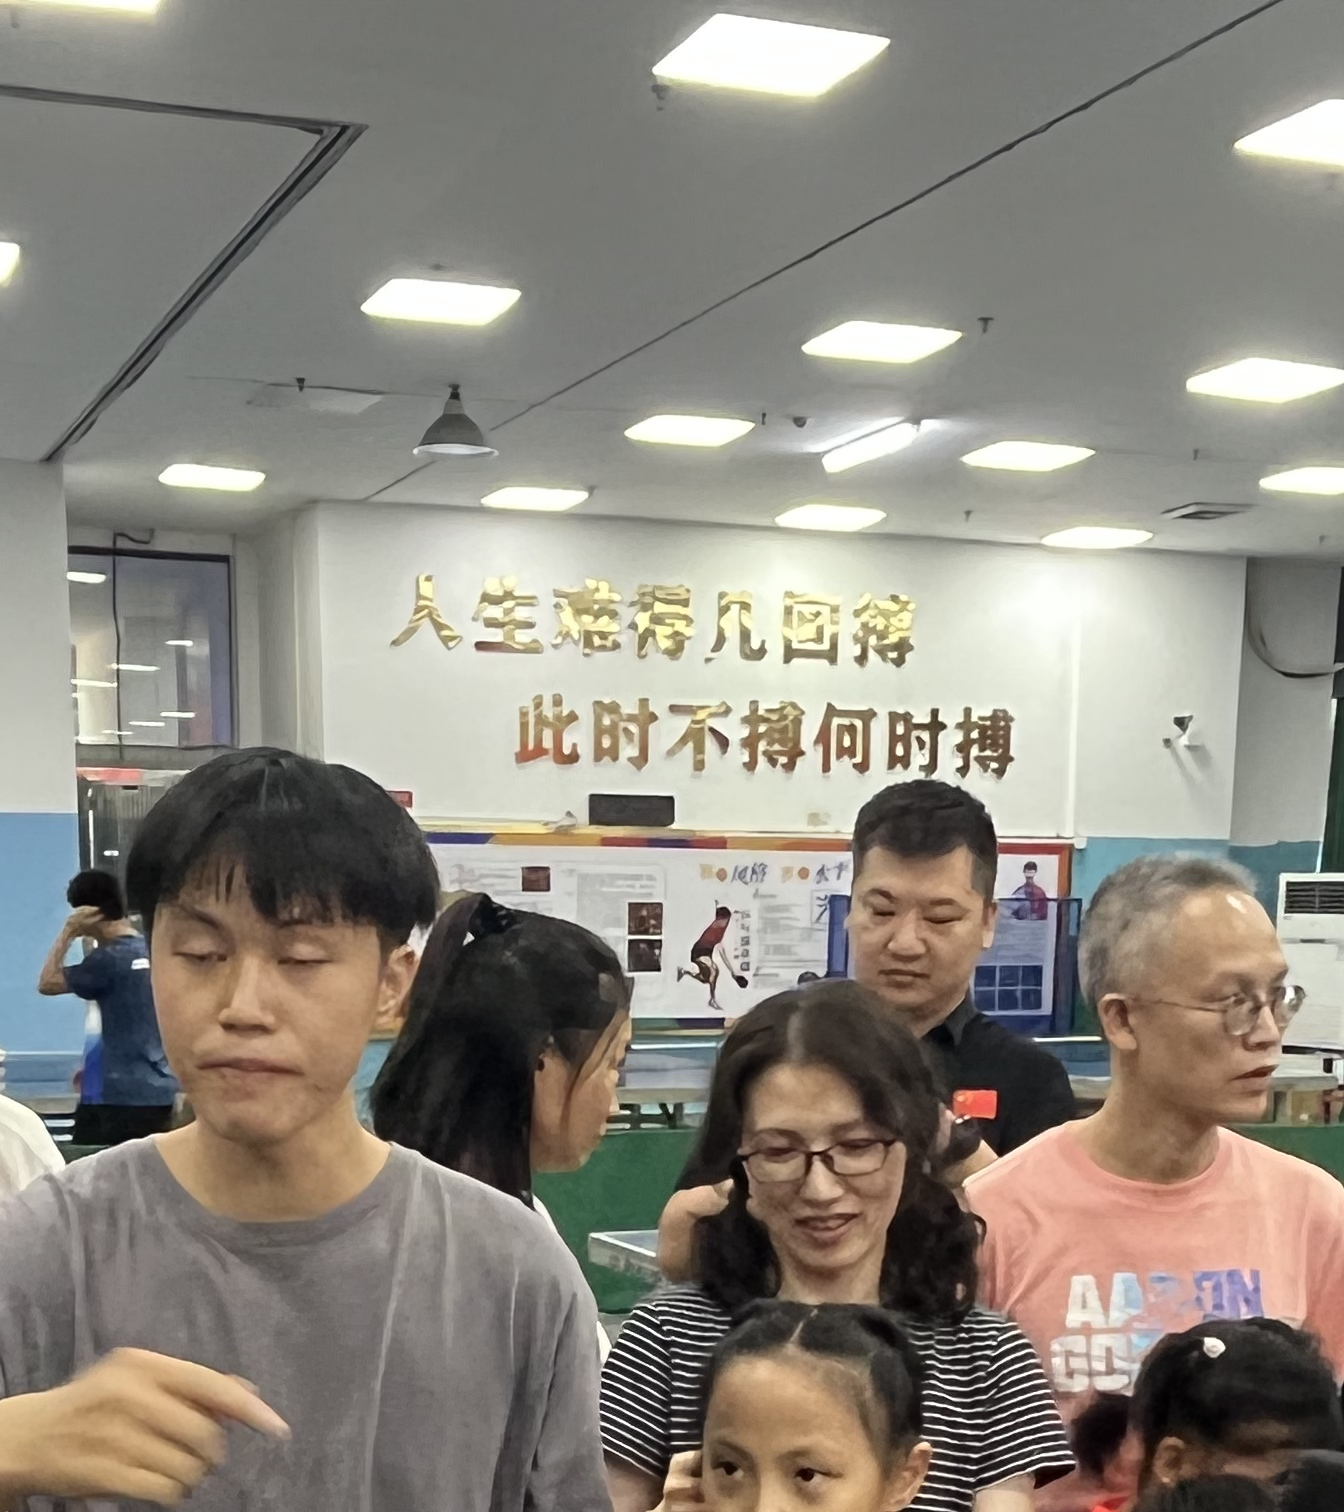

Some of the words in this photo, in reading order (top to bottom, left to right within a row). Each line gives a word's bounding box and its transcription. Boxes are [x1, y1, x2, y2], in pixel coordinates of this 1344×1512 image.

[390, 572, 918, 668] 人生难得几回搏
[513, 692, 1017, 779] 此时不搏何时搏
